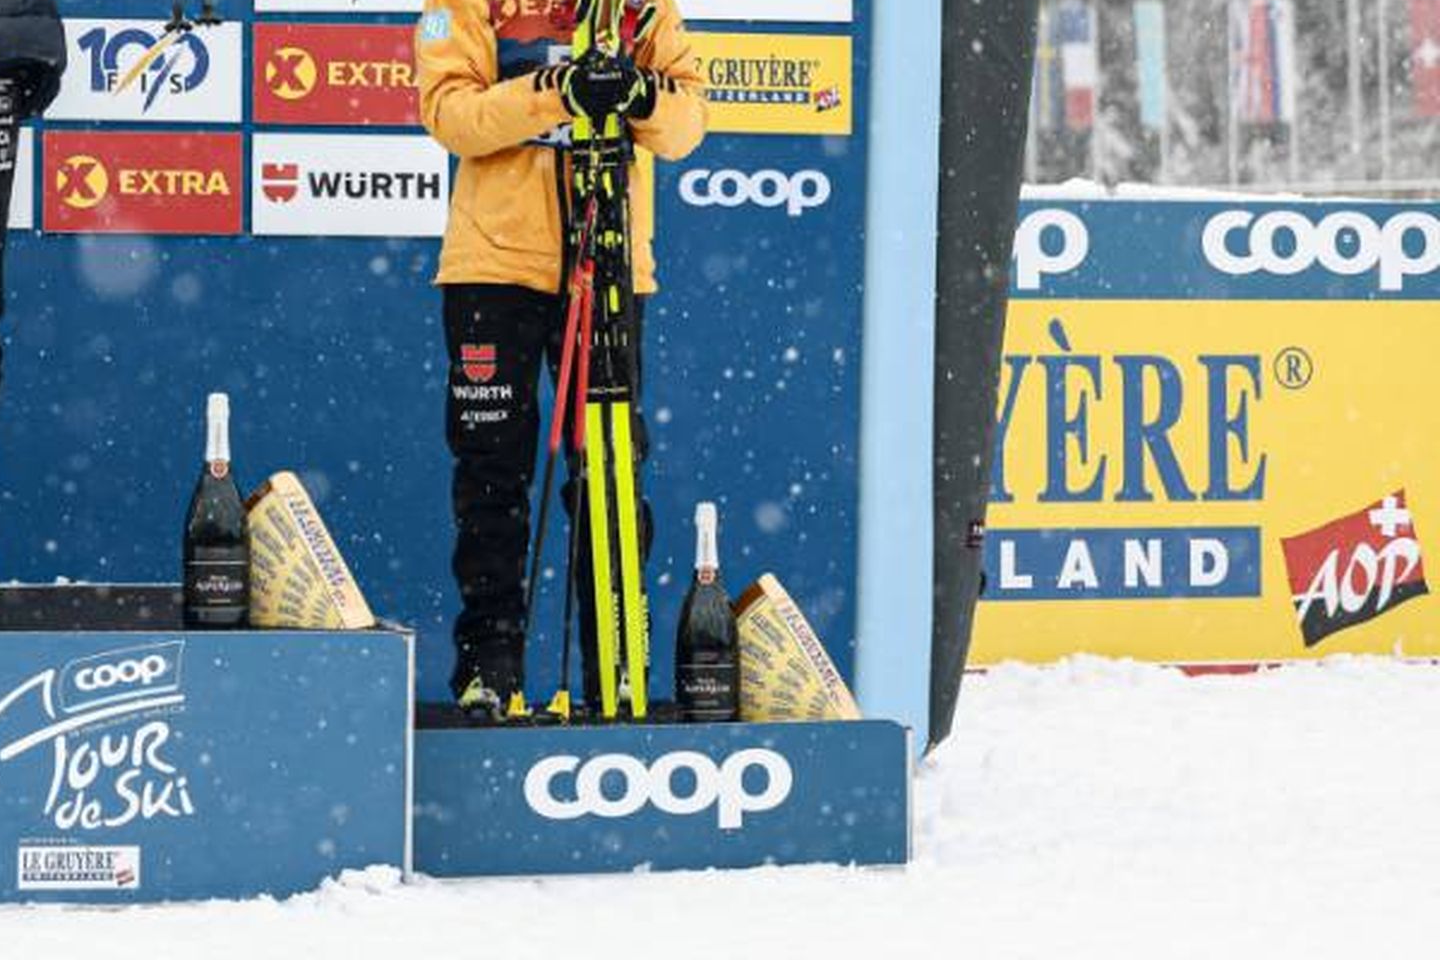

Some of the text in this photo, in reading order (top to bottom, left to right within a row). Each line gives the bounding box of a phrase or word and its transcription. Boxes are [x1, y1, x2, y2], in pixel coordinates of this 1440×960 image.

[709, 53, 812, 88] GRUYÈRE
[119, 169, 231, 196] EXTRA
[308, 170, 441, 201] WÜRTH
[679, 168, 832, 215] coop
[1202, 211, 1440, 290] coop
[1298, 537, 1420, 624] AOP
[74, 655, 166, 691] coop
[523, 748, 793, 830] coop
[22, 850, 42, 871] LE
